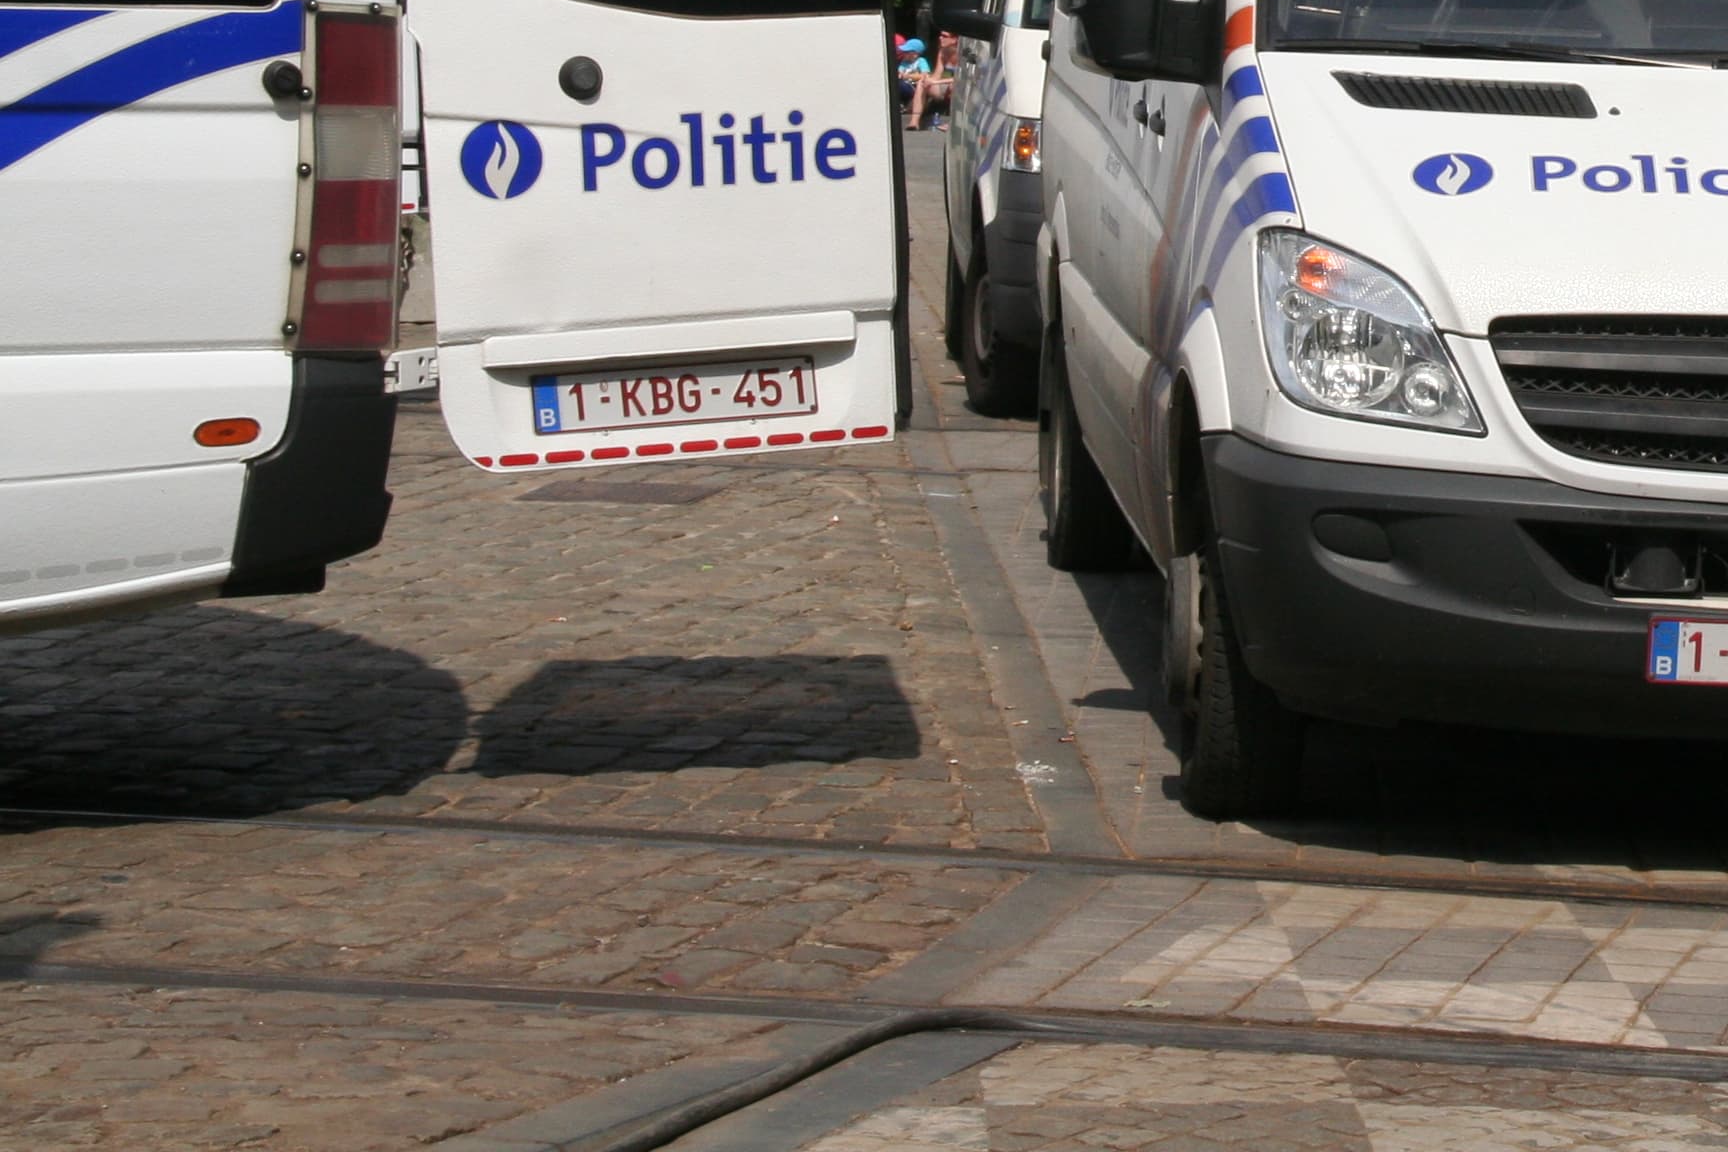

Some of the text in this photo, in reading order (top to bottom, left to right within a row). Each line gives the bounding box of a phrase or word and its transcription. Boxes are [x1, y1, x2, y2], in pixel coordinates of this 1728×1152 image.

[581, 110, 857, 191] Politie
[540, 366, 805, 428] B 1-KBG-451
[1655, 652, 1673, 675] B
